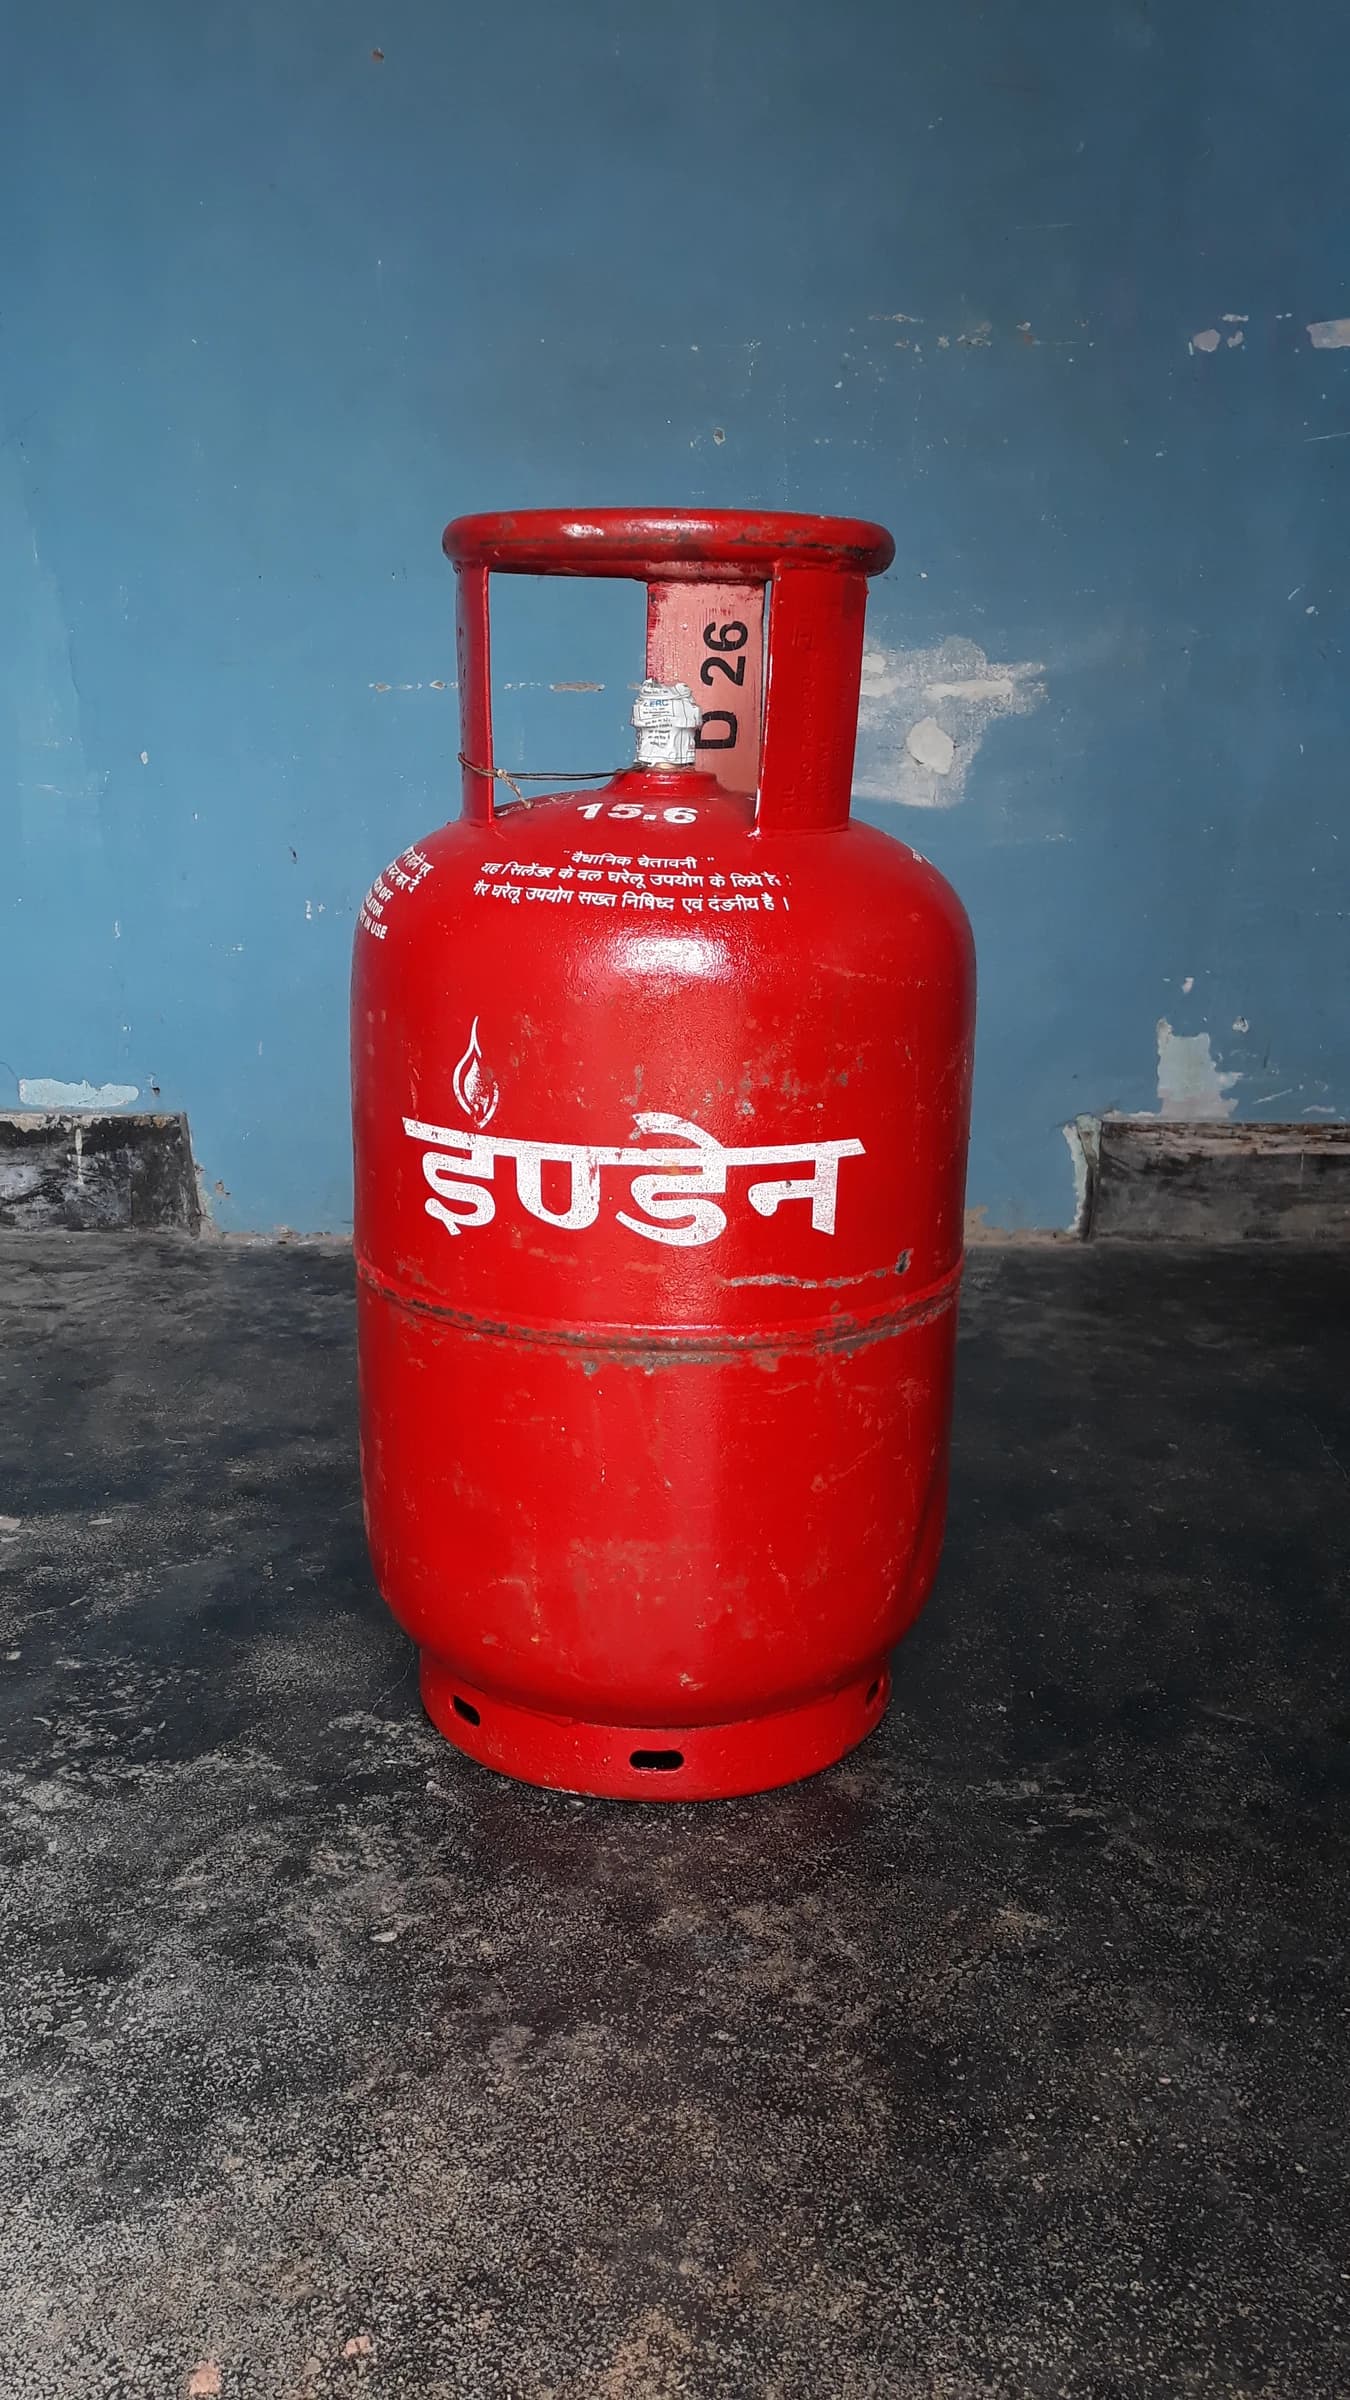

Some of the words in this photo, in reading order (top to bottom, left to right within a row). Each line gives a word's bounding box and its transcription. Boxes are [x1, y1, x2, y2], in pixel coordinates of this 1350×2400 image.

[700, 620, 749, 687] 26
[577, 802, 699, 824] 15.6
[637, 854, 698, 869] चेतावनी
[608, 868, 647, 889] घरेलू
[649, 871, 704, 887] उपयोग
[708, 872, 726, 888] के
[491, 882, 523, 904] घरेलू
[525, 885, 574, 904] उपयोग
[577, 891, 617, 908] सख्त
[681, 894, 704, 913] एवं
[760, 891, 775, 911] है
[370, 920, 388, 940] USE
[401, 1111, 867, 1247] इण्डेन
